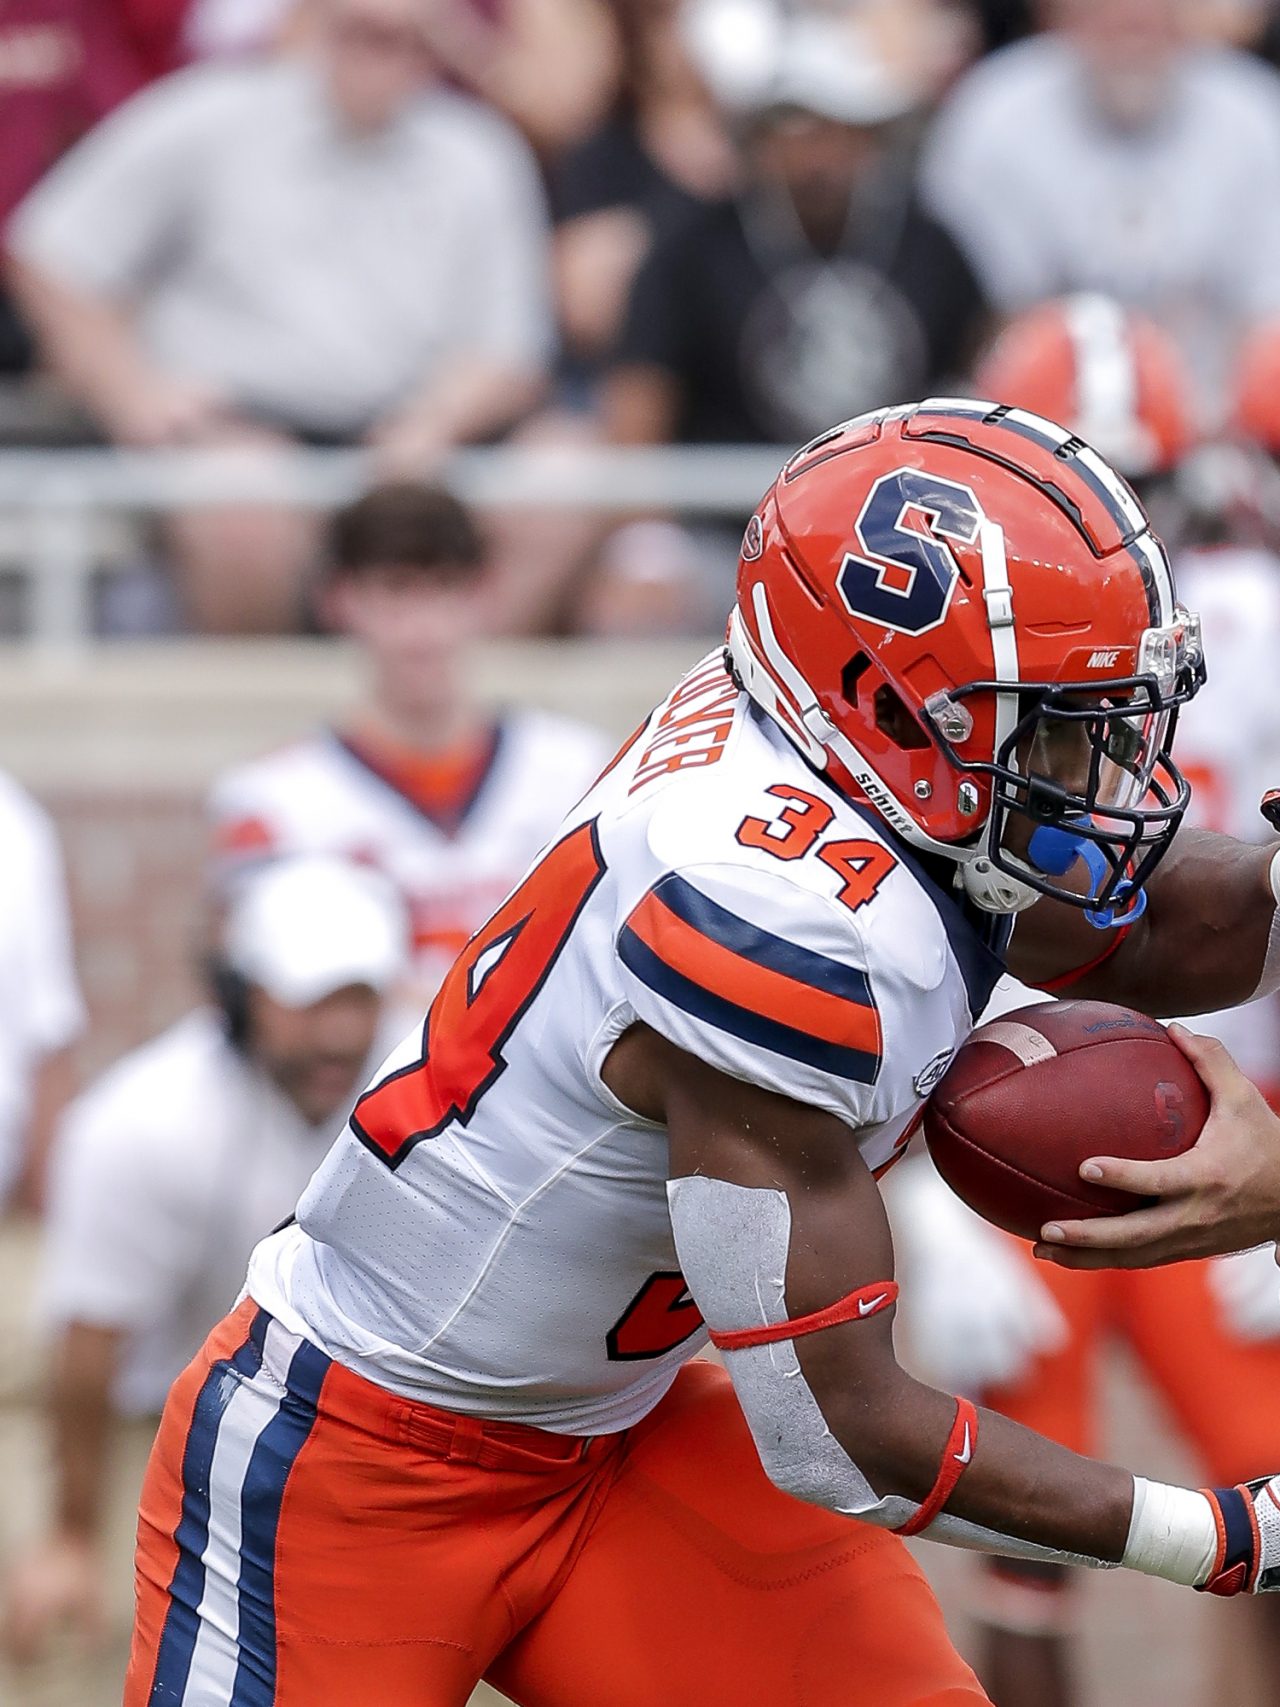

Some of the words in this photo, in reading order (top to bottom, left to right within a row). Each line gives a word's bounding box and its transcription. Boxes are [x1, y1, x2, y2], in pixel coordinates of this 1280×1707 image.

[835, 465, 985, 637] S
[627, 653, 739, 797] UCKER
[1086, 651, 1120, 668] NIKE
[734, 783, 901, 914] 34
[350, 715, 652, 1172] 4
